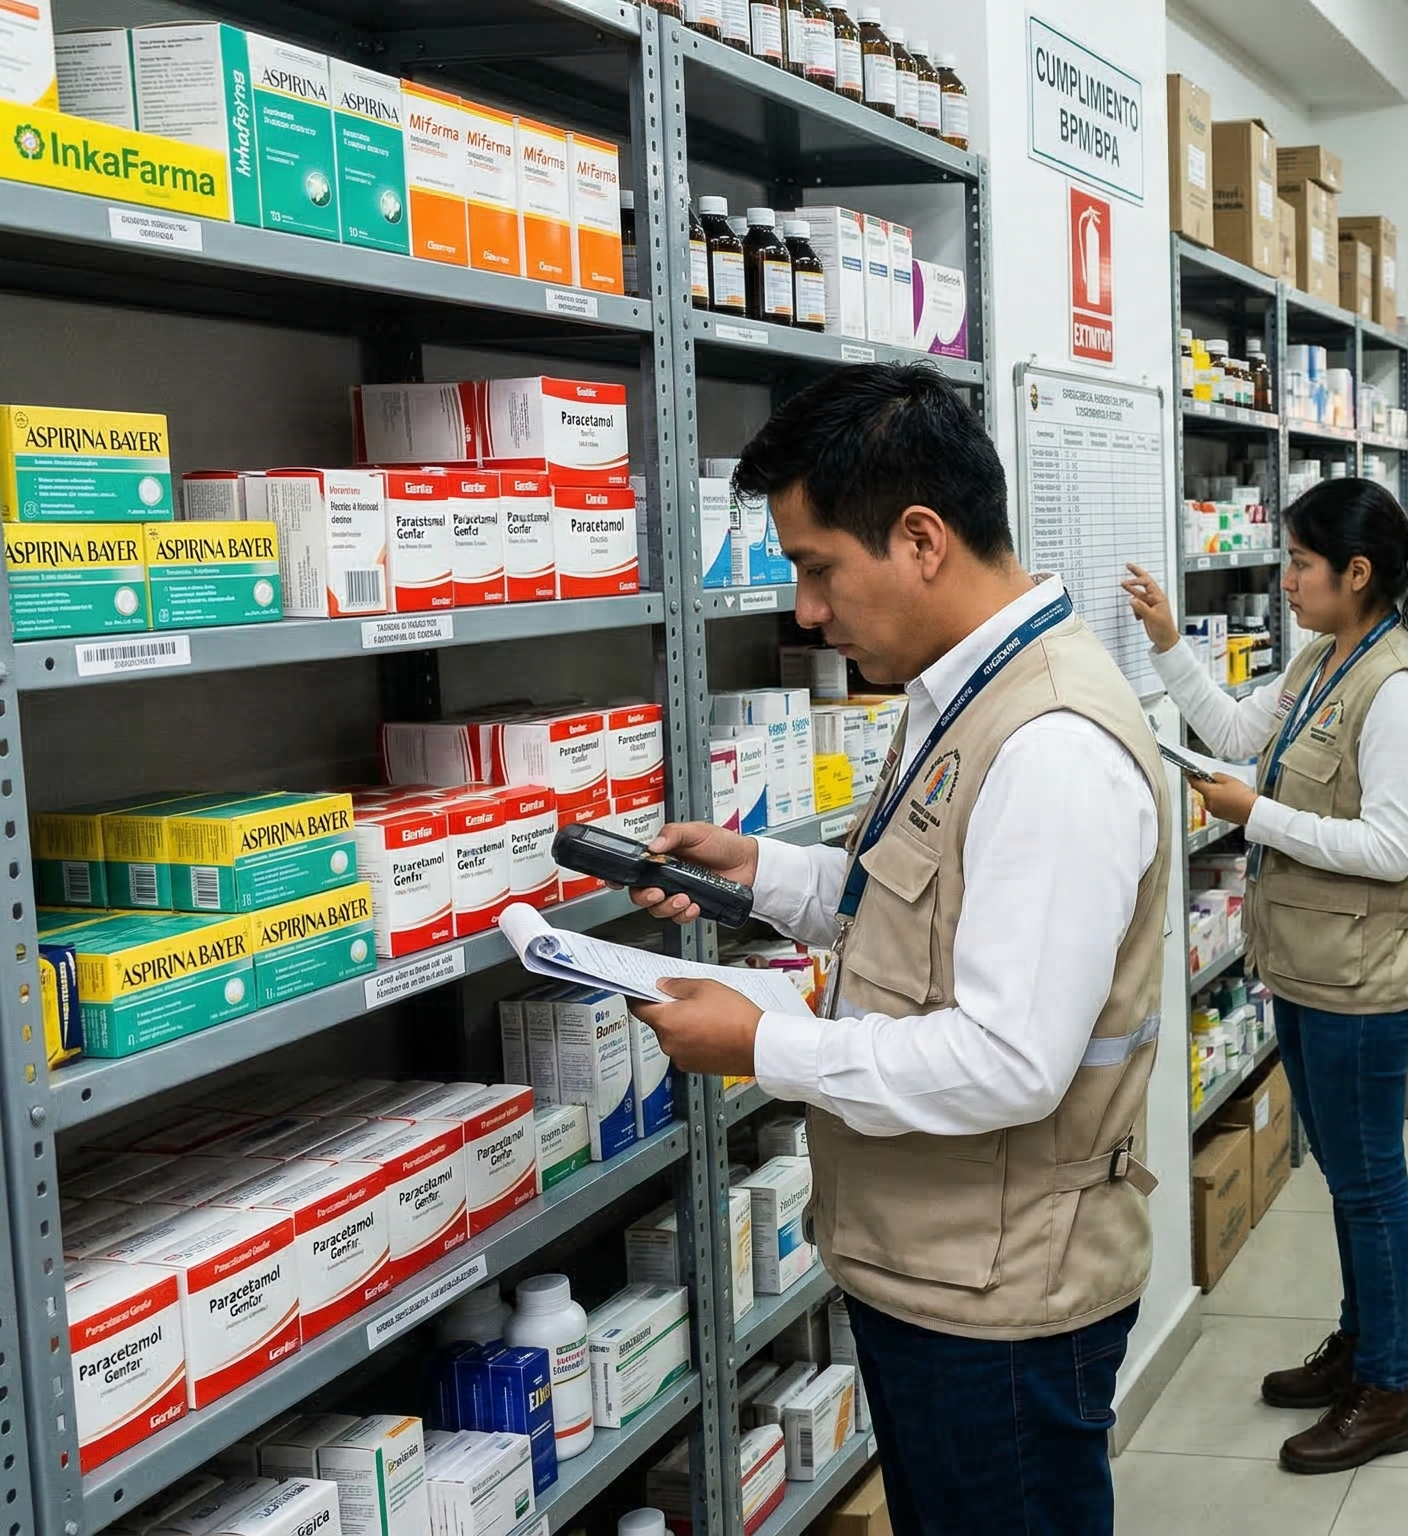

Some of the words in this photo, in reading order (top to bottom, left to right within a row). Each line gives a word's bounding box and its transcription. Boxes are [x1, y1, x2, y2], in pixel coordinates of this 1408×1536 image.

[262, 67, 328, 101] ASPIRINA
[1036, 47, 1139, 133] CUMPLIMIENTO
[340, 92, 400, 123] ASPIRINA
[1060, 108, 1120, 168] BPM/BPA
[51, 137, 216, 197] InkaFarma
[1074, 322, 1112, 354] EXTINTOR
[25, 427, 106, 453] ASPIRINA
[110, 430, 161, 452] BAYER
[571, 517, 624, 533] Paracetamol
[5, 541, 84, 567] ASPIRINA
[89, 540, 138, 562] BAYER
[156, 539, 225, 562] ASPIRINA
[228, 537, 274, 558] BAYER
[240, 818, 304, 852] ASPIRINA
[307, 809, 350, 837] BAYER
[260, 913, 327, 947] ASPIRINA
[327, 898, 369, 927] BAYER
[120, 952, 198, 991] ASPIRINA
[200, 934, 246, 965] BAYER
[313, 1211, 374, 1255] Paracetamol
[209, 1264, 280, 1314] Paracetamol
[79, 1325, 162, 1381] Paracetamol
